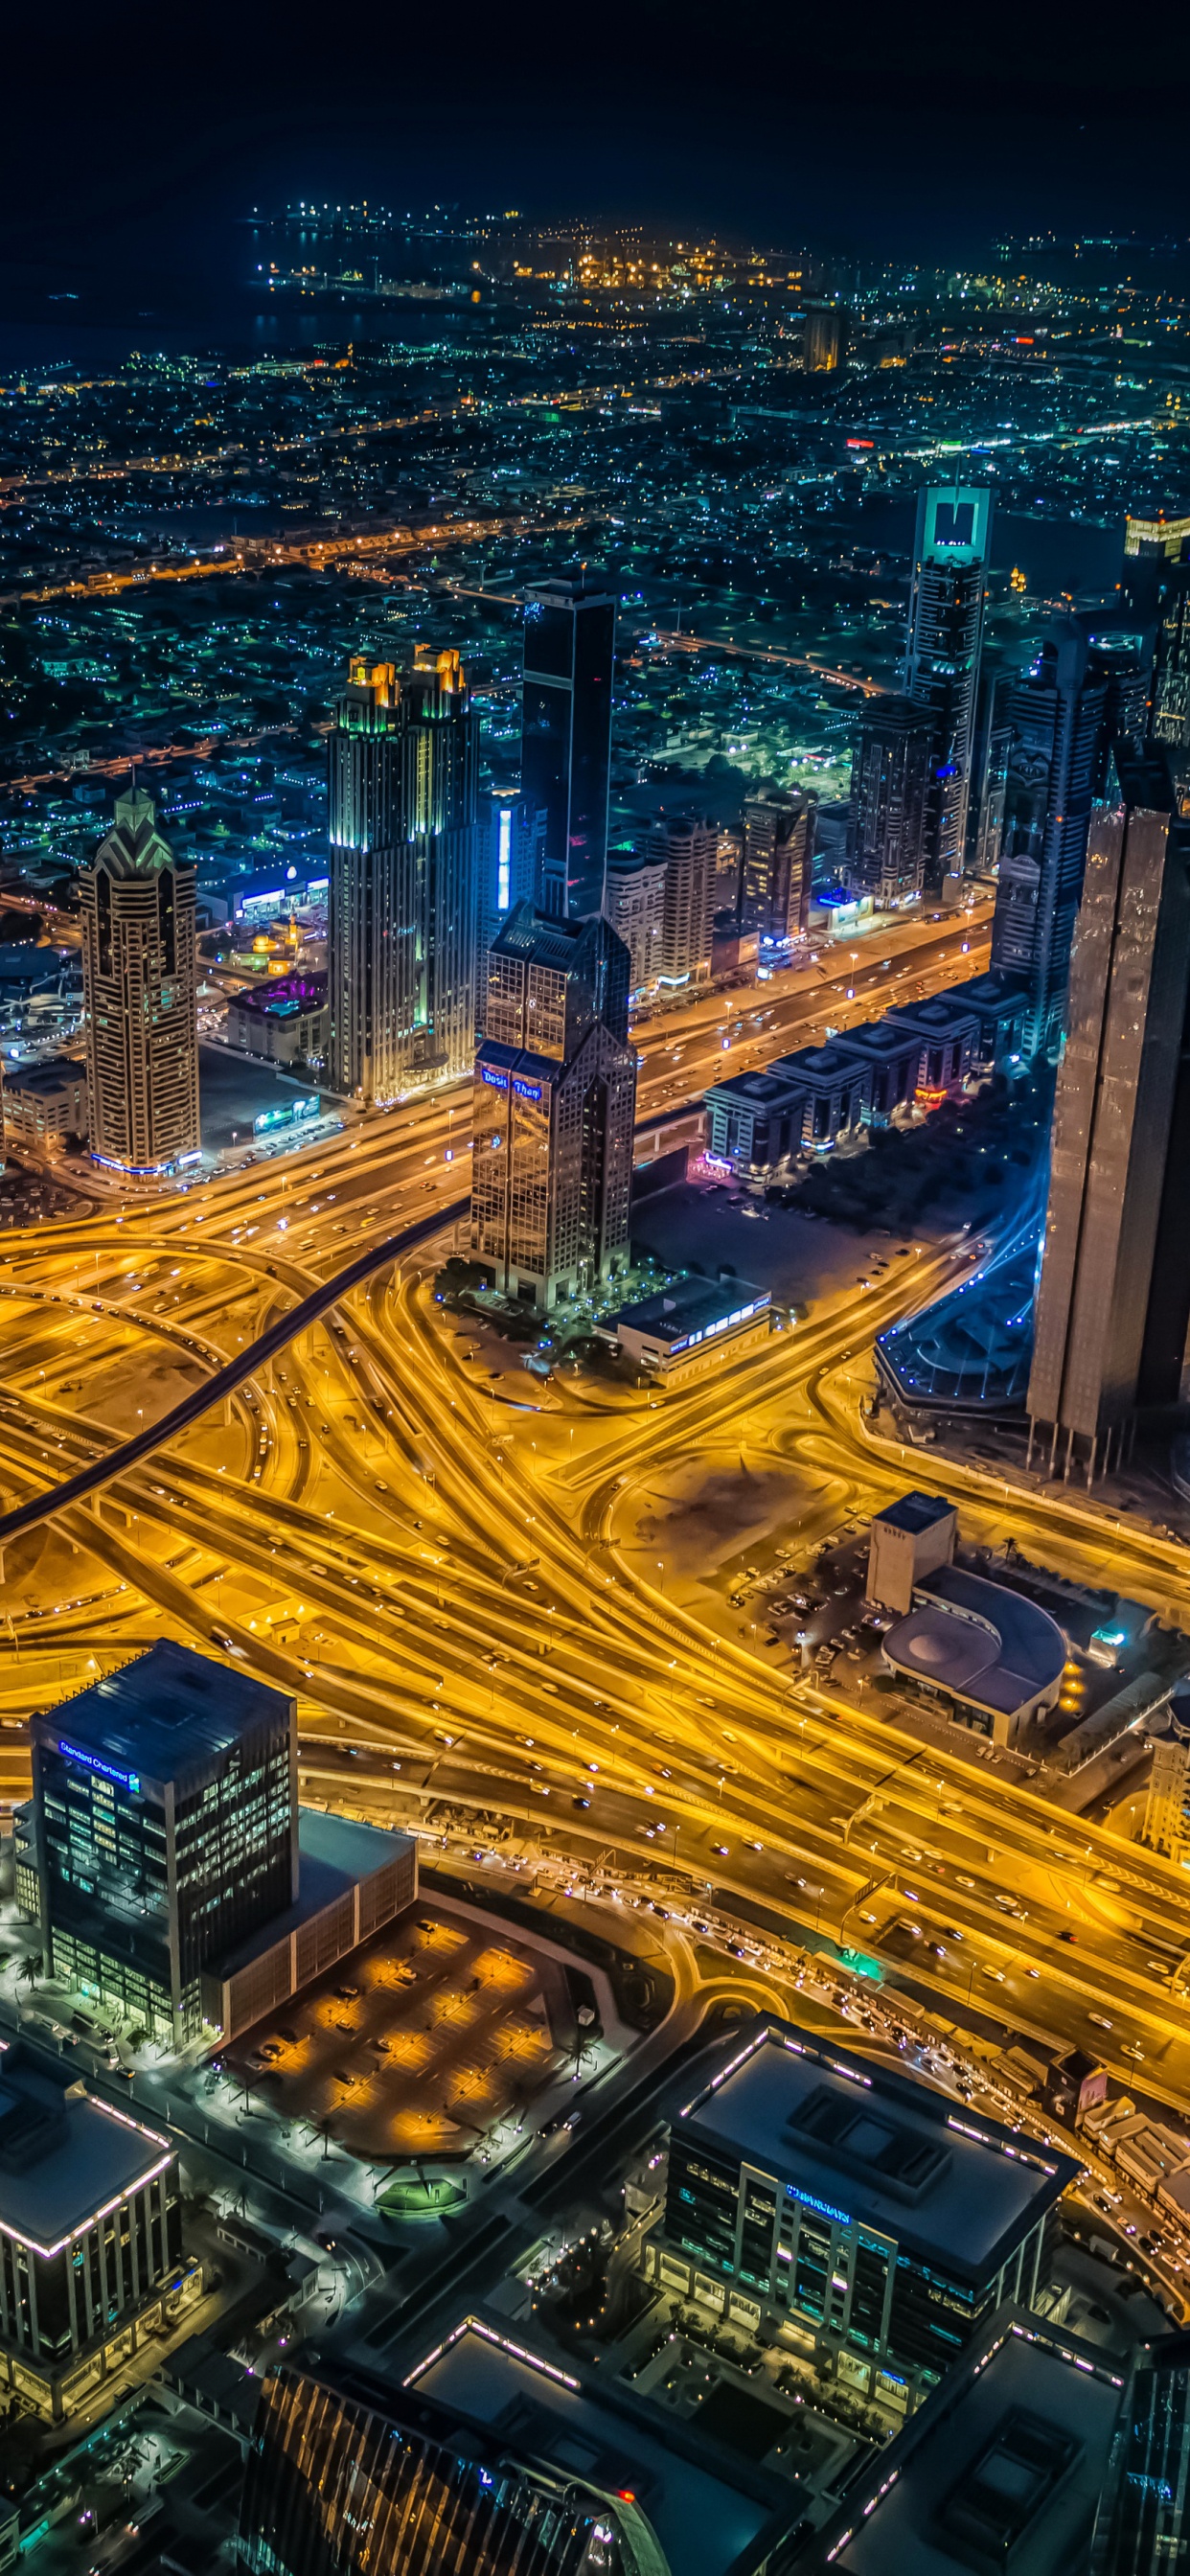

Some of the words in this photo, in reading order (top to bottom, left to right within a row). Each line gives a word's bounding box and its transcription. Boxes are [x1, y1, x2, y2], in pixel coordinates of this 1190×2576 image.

[483, 1070, 508, 1089] Dusit
[514, 1081, 540, 1100] Thani
[60, 1741, 93, 1764] Standard
[93, 1759, 127, 1782] Chartered
[799, 2192, 850, 2223] BARCLAYS
